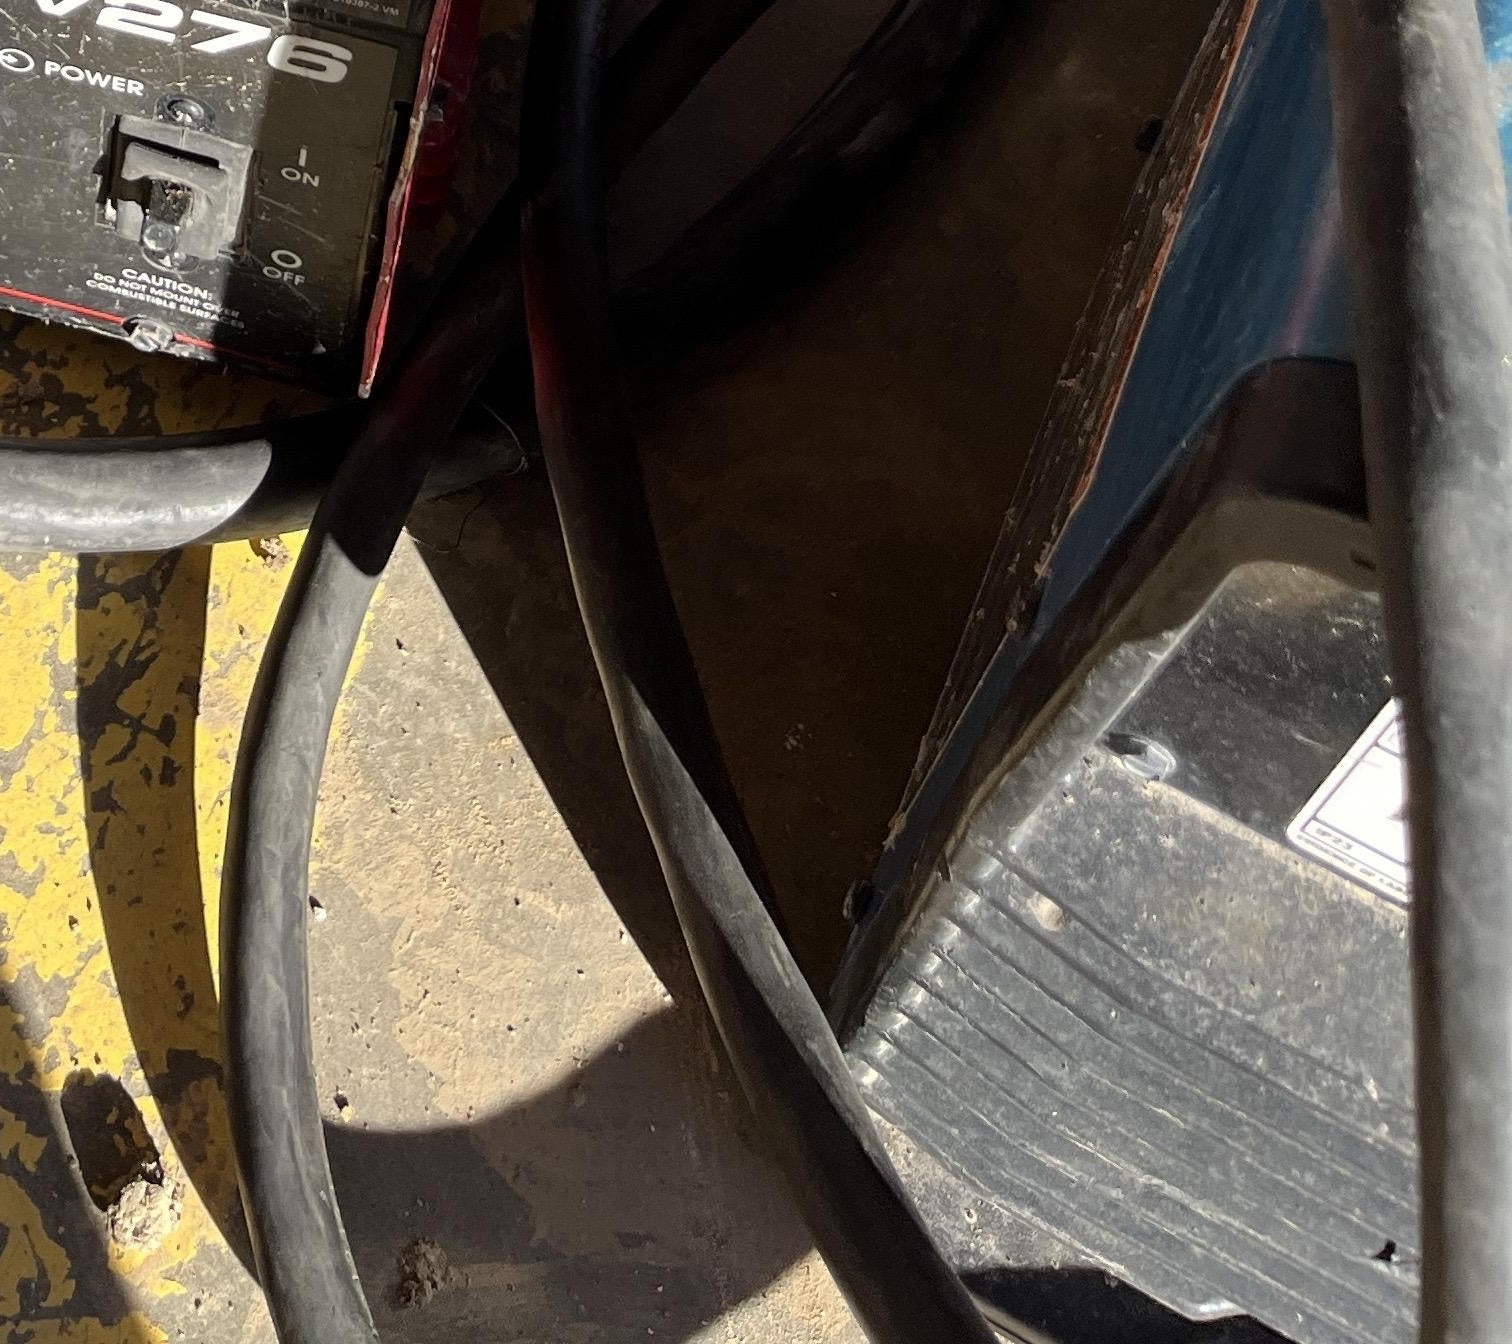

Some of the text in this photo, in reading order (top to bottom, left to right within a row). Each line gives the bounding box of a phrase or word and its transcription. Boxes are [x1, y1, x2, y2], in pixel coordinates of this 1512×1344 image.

[43, 60, 146, 97] POWER
[280, 166, 320, 188] ON
[92, 272, 116, 285] DO
[118, 278, 148, 292] NOT
[149, 286, 200, 307] MOUNT
[120, 268, 214, 302] CAUTION:
[261, 265, 306, 286] OFF
[85, 278, 178, 310] COMBUSTIBLE
